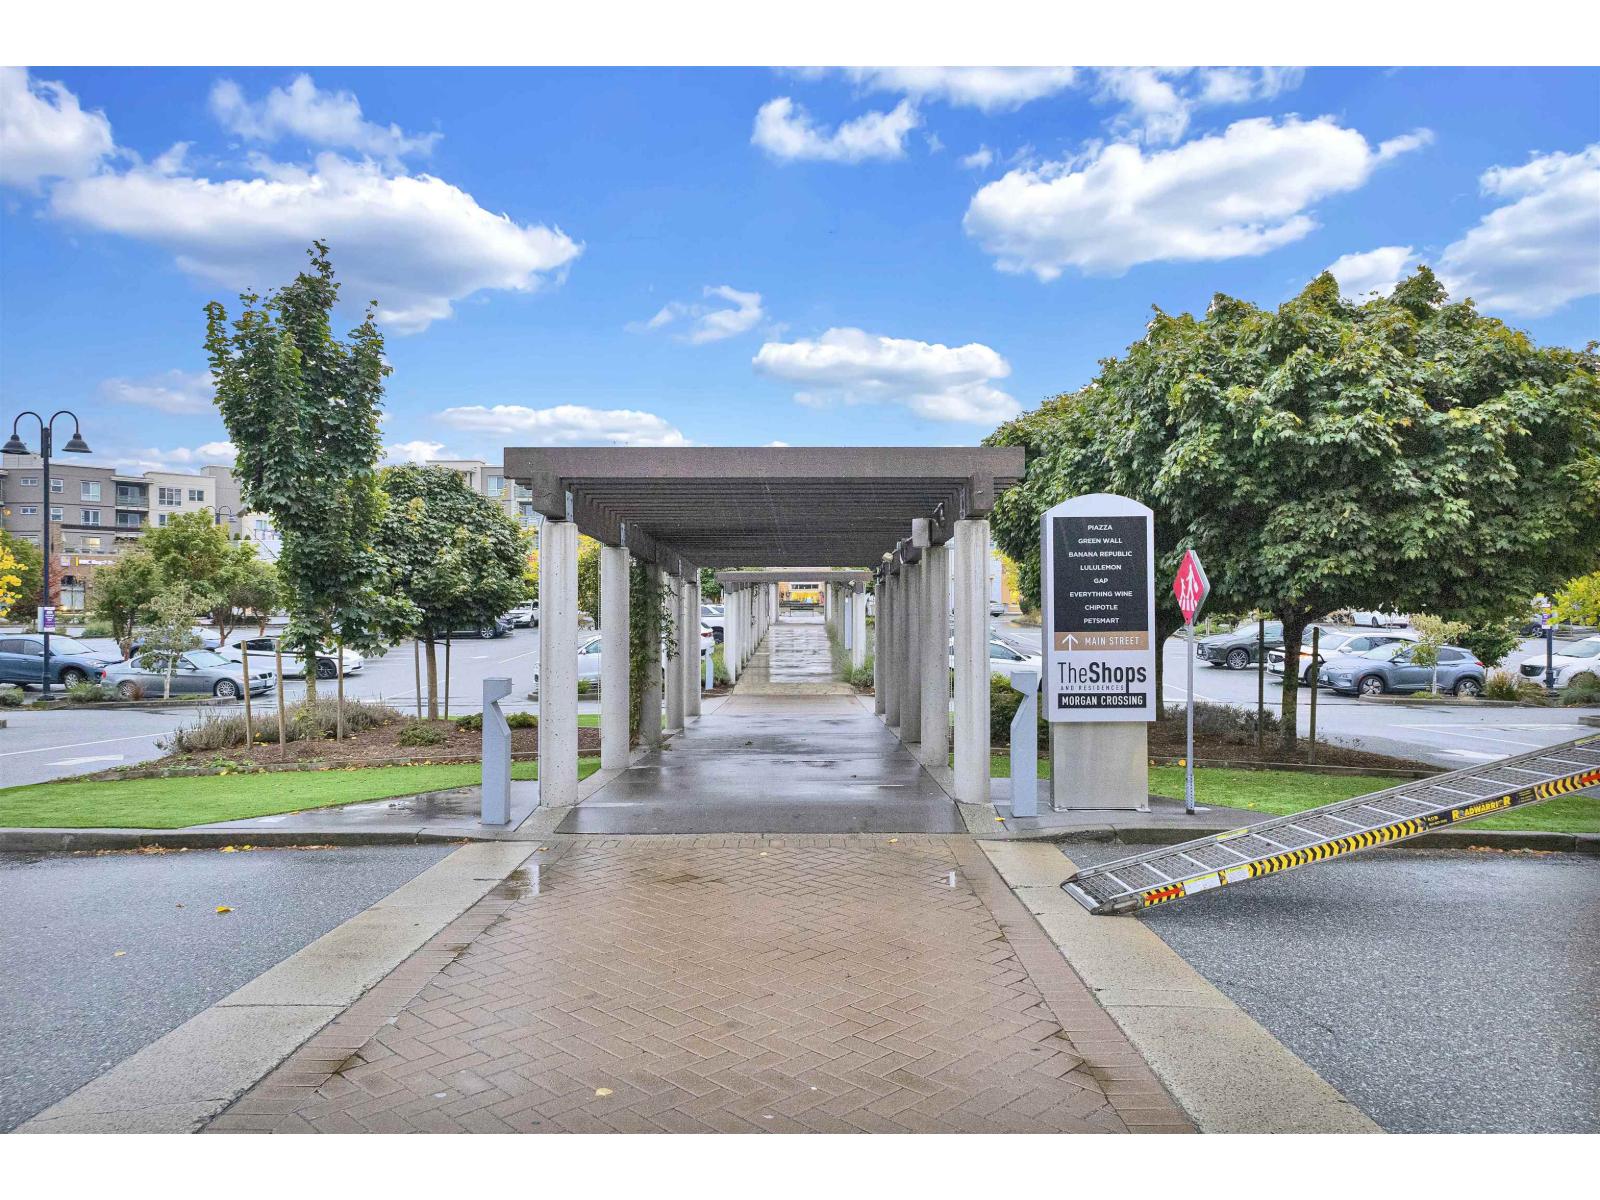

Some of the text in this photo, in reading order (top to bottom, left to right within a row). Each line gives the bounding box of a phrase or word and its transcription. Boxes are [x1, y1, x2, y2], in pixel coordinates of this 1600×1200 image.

[1084, 636, 1140, 646] MAIN STREET
[1061, 695, 1143, 706] MORGAN CROSSING
